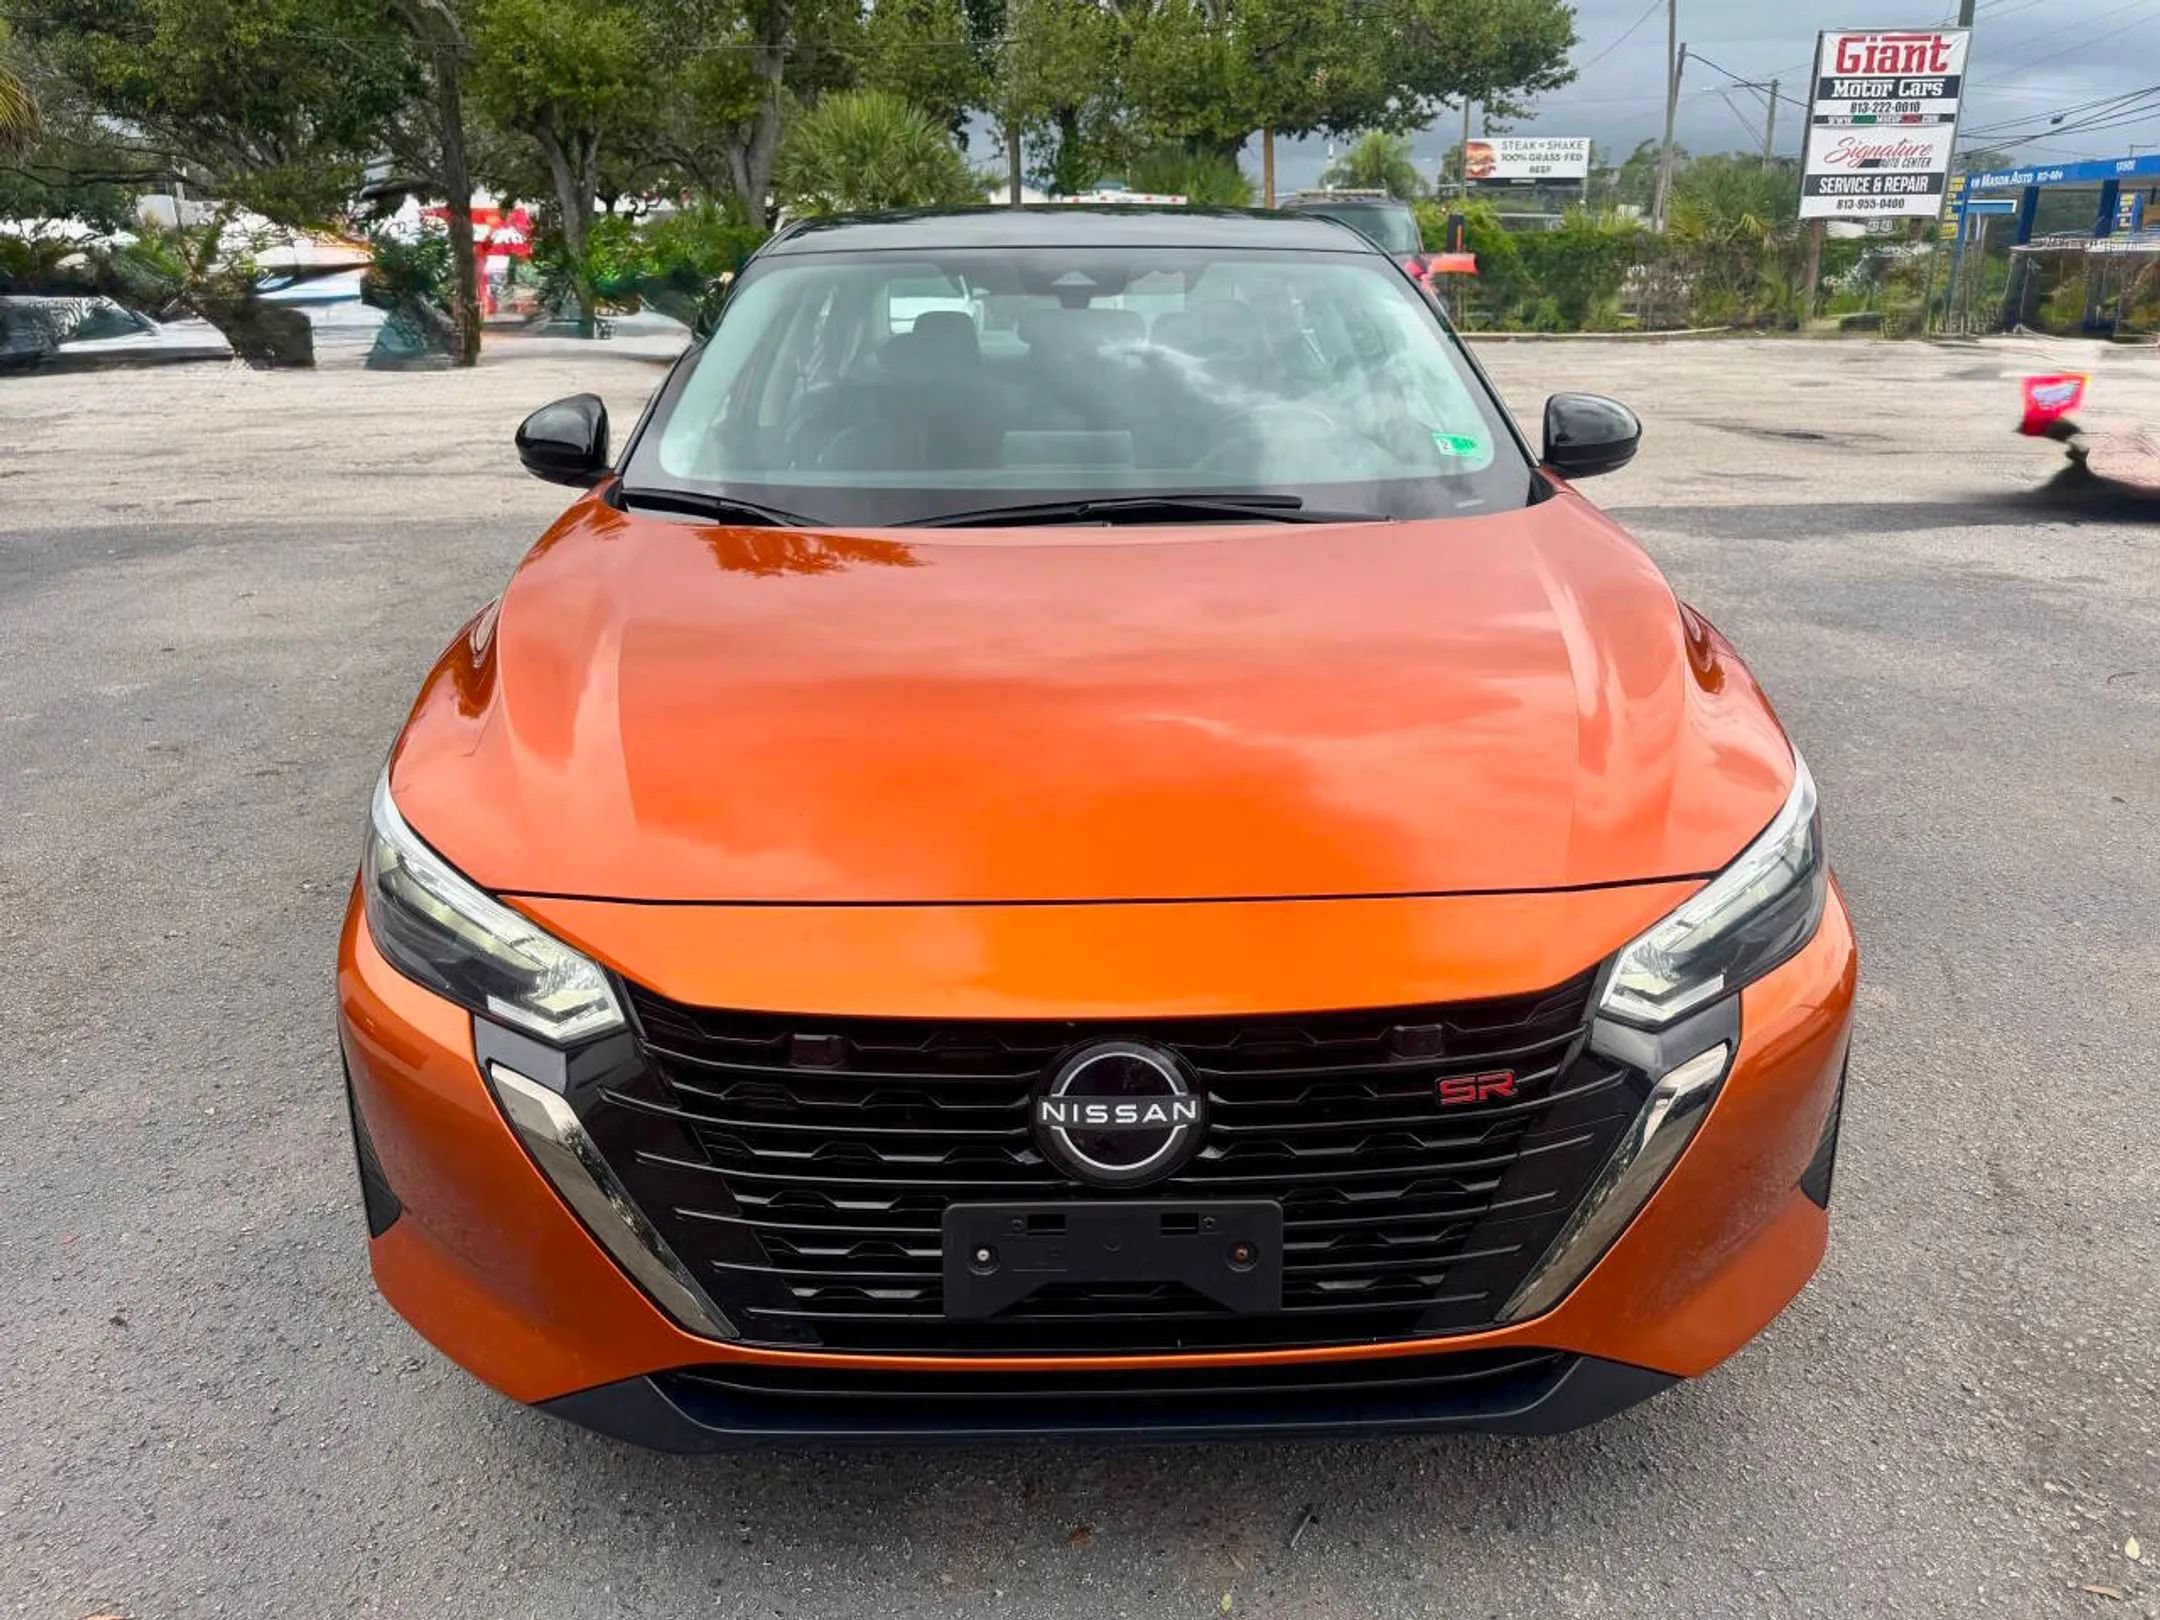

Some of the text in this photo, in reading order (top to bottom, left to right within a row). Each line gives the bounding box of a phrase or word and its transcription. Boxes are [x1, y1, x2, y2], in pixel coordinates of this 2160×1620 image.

[1836, 34, 1952, 74] Giant
[1831, 78, 1946, 98] Motor Cars
[1850, 101, 1920, 113] 813-222-0010
[1501, 140, 1536, 150] STEAK
[1546, 140, 1585, 150] SHAKE
[1824, 136, 1934, 168] Signature
[1500, 153, 1527, 161] 100%
[1901, 157, 1932, 168] CENTER
[1529, 165, 1552, 174] BEEF
[1819, 176, 1929, 194] SERVICE & REPAIR
[1438, 1070, 1516, 1105] SR
[1042, 1100, 1197, 1124] NISSAN
